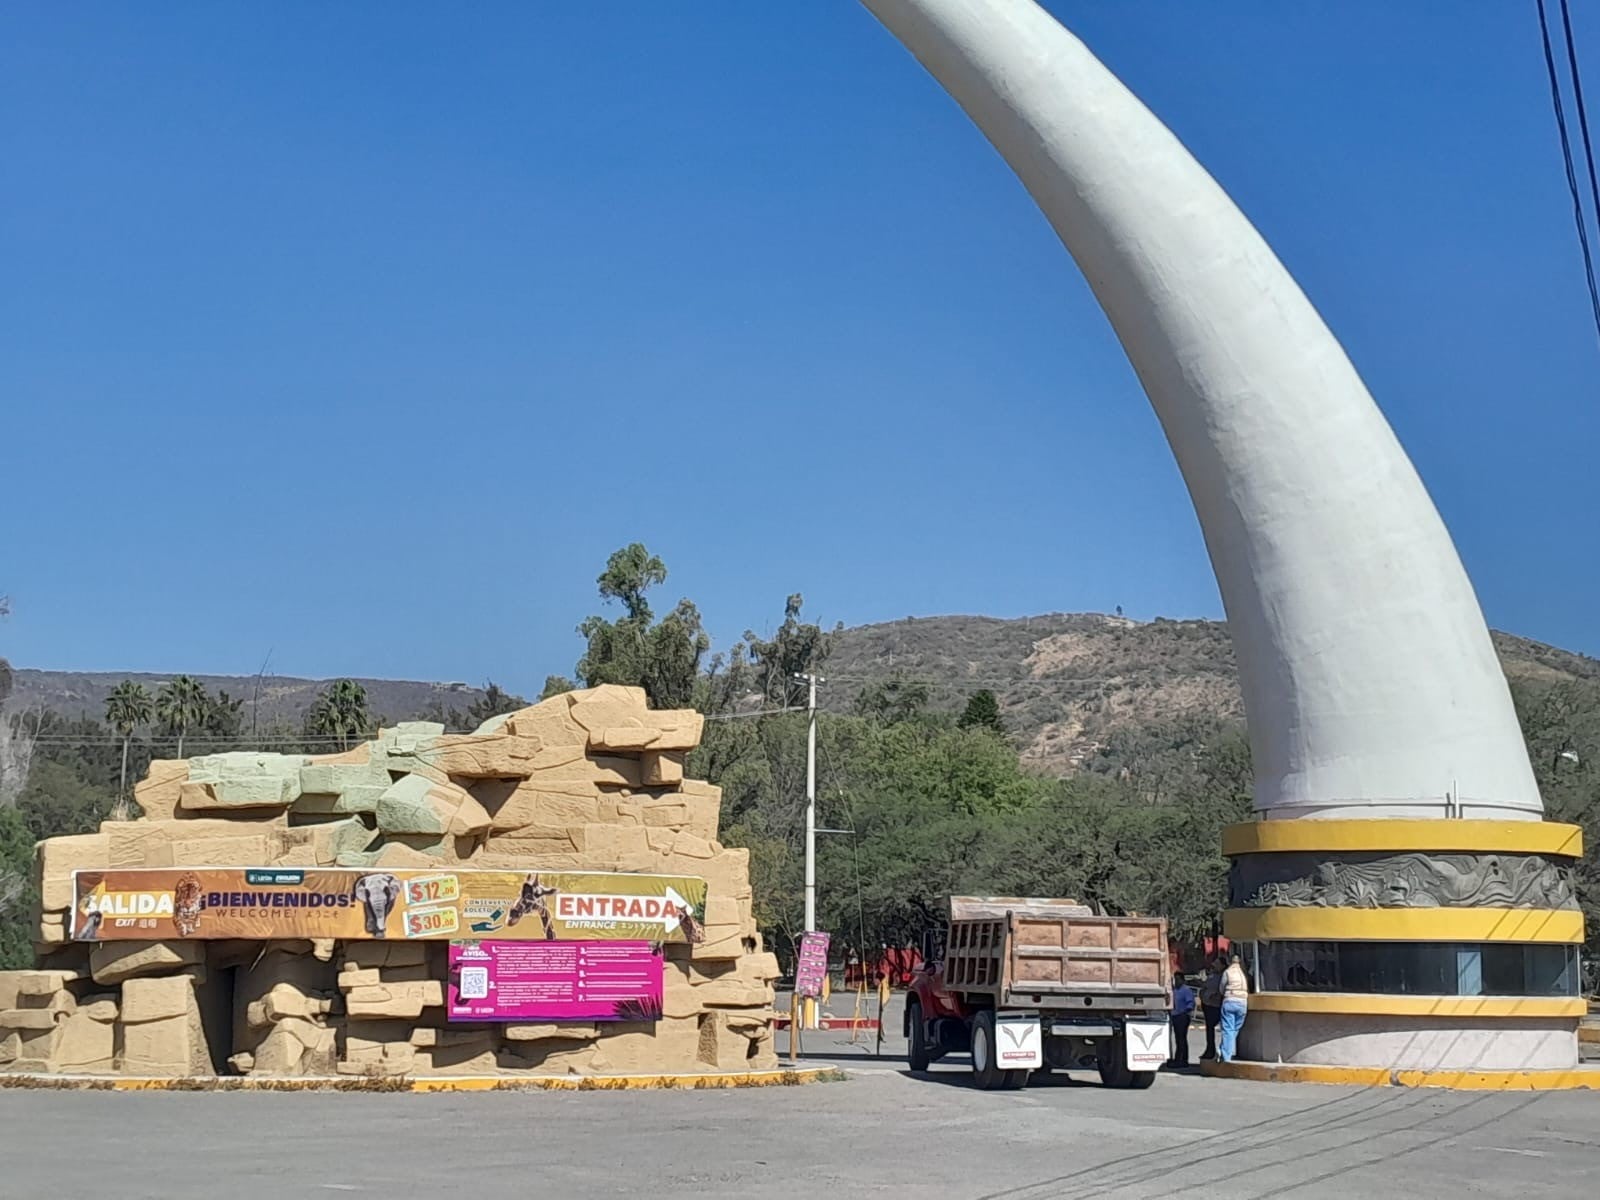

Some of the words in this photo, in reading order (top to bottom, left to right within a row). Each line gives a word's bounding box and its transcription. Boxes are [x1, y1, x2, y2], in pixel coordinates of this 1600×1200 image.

[559, 897, 679, 918] ENTRADA
[215, 908, 297, 918] WELCOME!
[115, 918, 137, 928] EXIT
[565, 920, 617, 929] ENTRANCE
